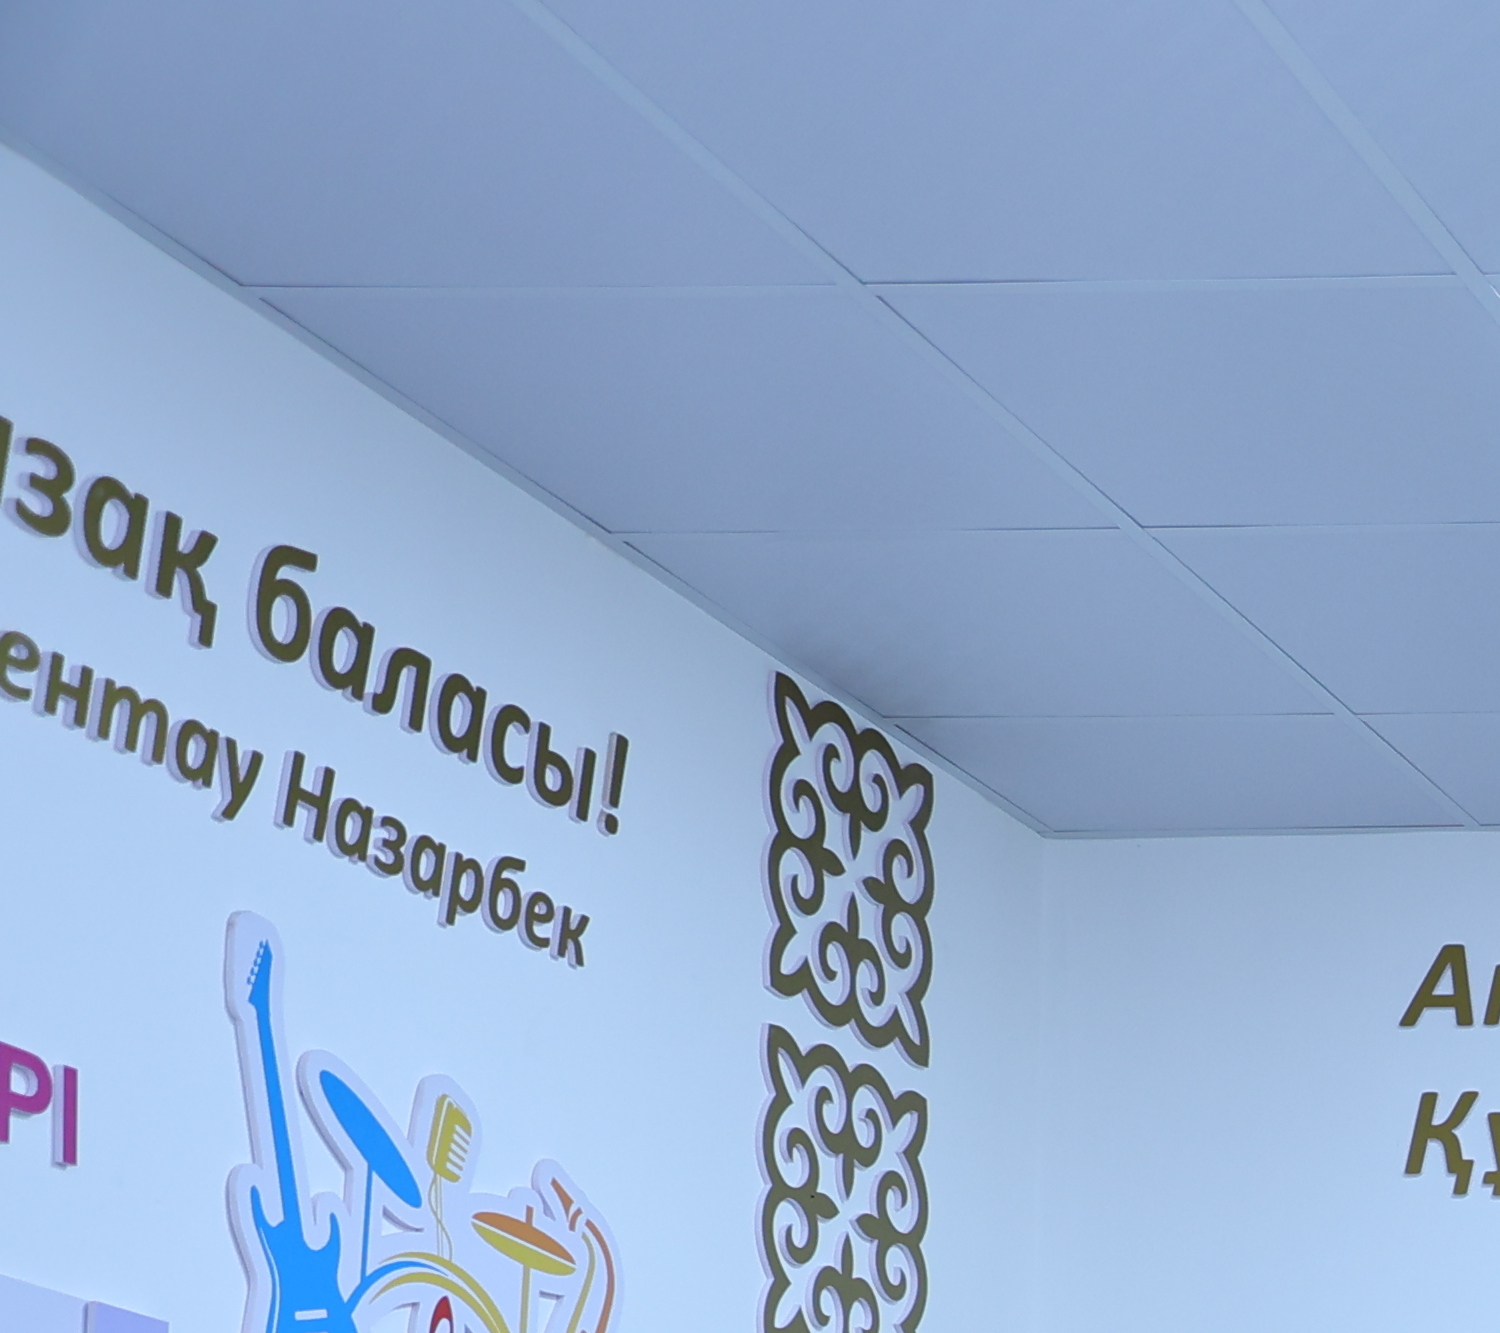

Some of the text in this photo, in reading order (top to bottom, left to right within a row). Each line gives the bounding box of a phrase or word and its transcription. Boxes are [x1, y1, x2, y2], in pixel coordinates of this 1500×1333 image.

[0, 416, 629, 836] зақ баласы!
[275, 750, 590, 967] Назарбек
